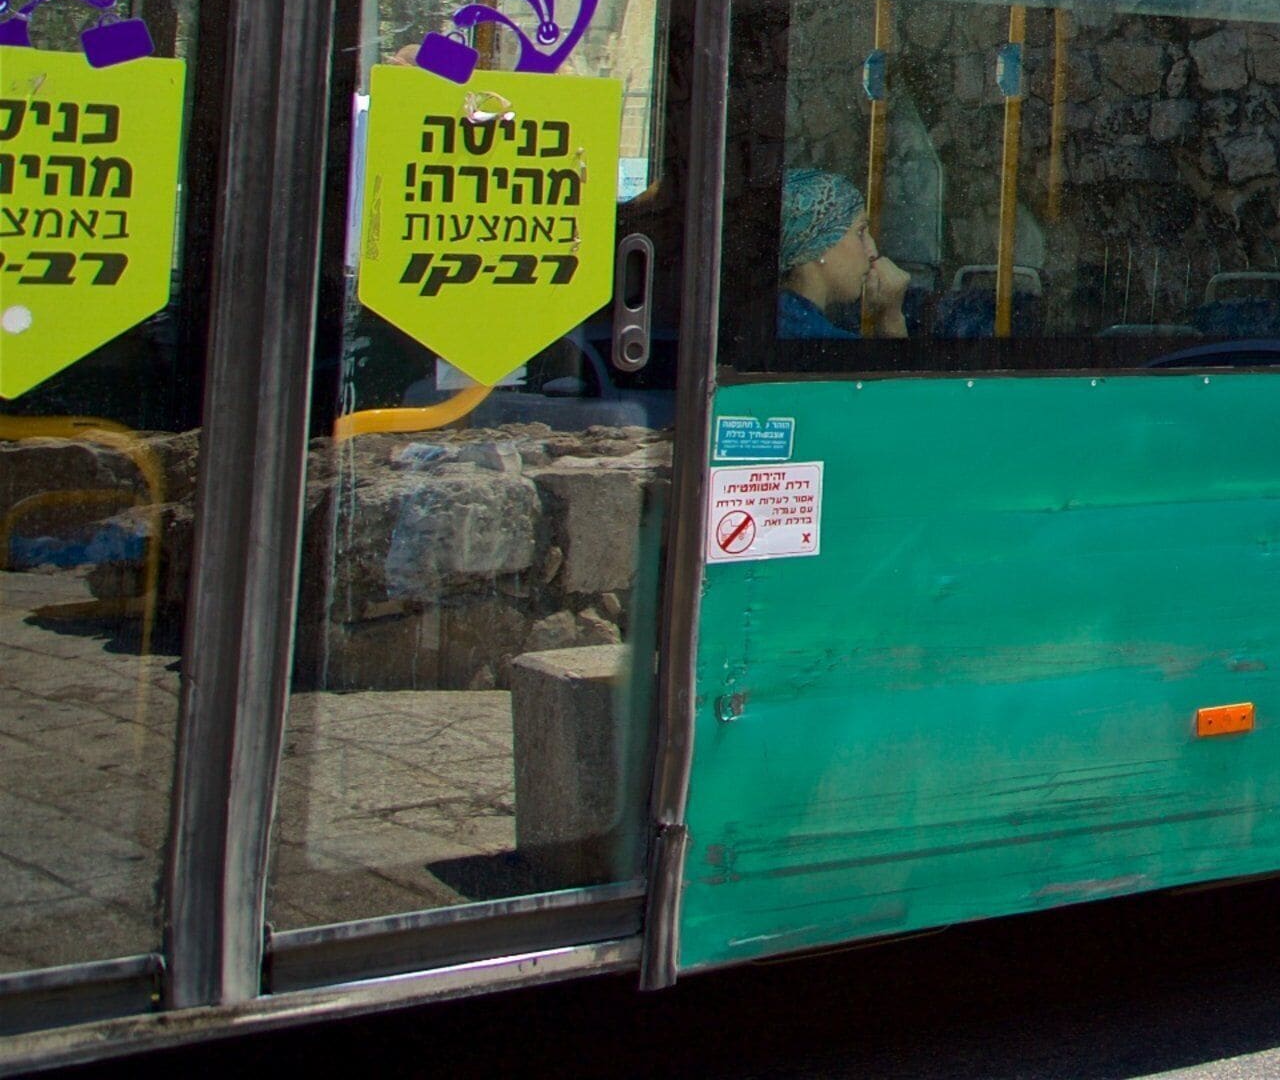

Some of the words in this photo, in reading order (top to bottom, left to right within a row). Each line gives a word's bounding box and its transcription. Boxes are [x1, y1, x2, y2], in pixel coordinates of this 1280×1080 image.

[0, 99, 120, 144] כניס
[420, 115, 570, 158] כניסה
[404, 162, 580, 206] מהירה!
[0, 207, 130, 239] באמצ
[401, 212, 578, 243] באמצעות
[749, 472, 786, 482] זהירות
[785, 480, 810, 490] דלת
